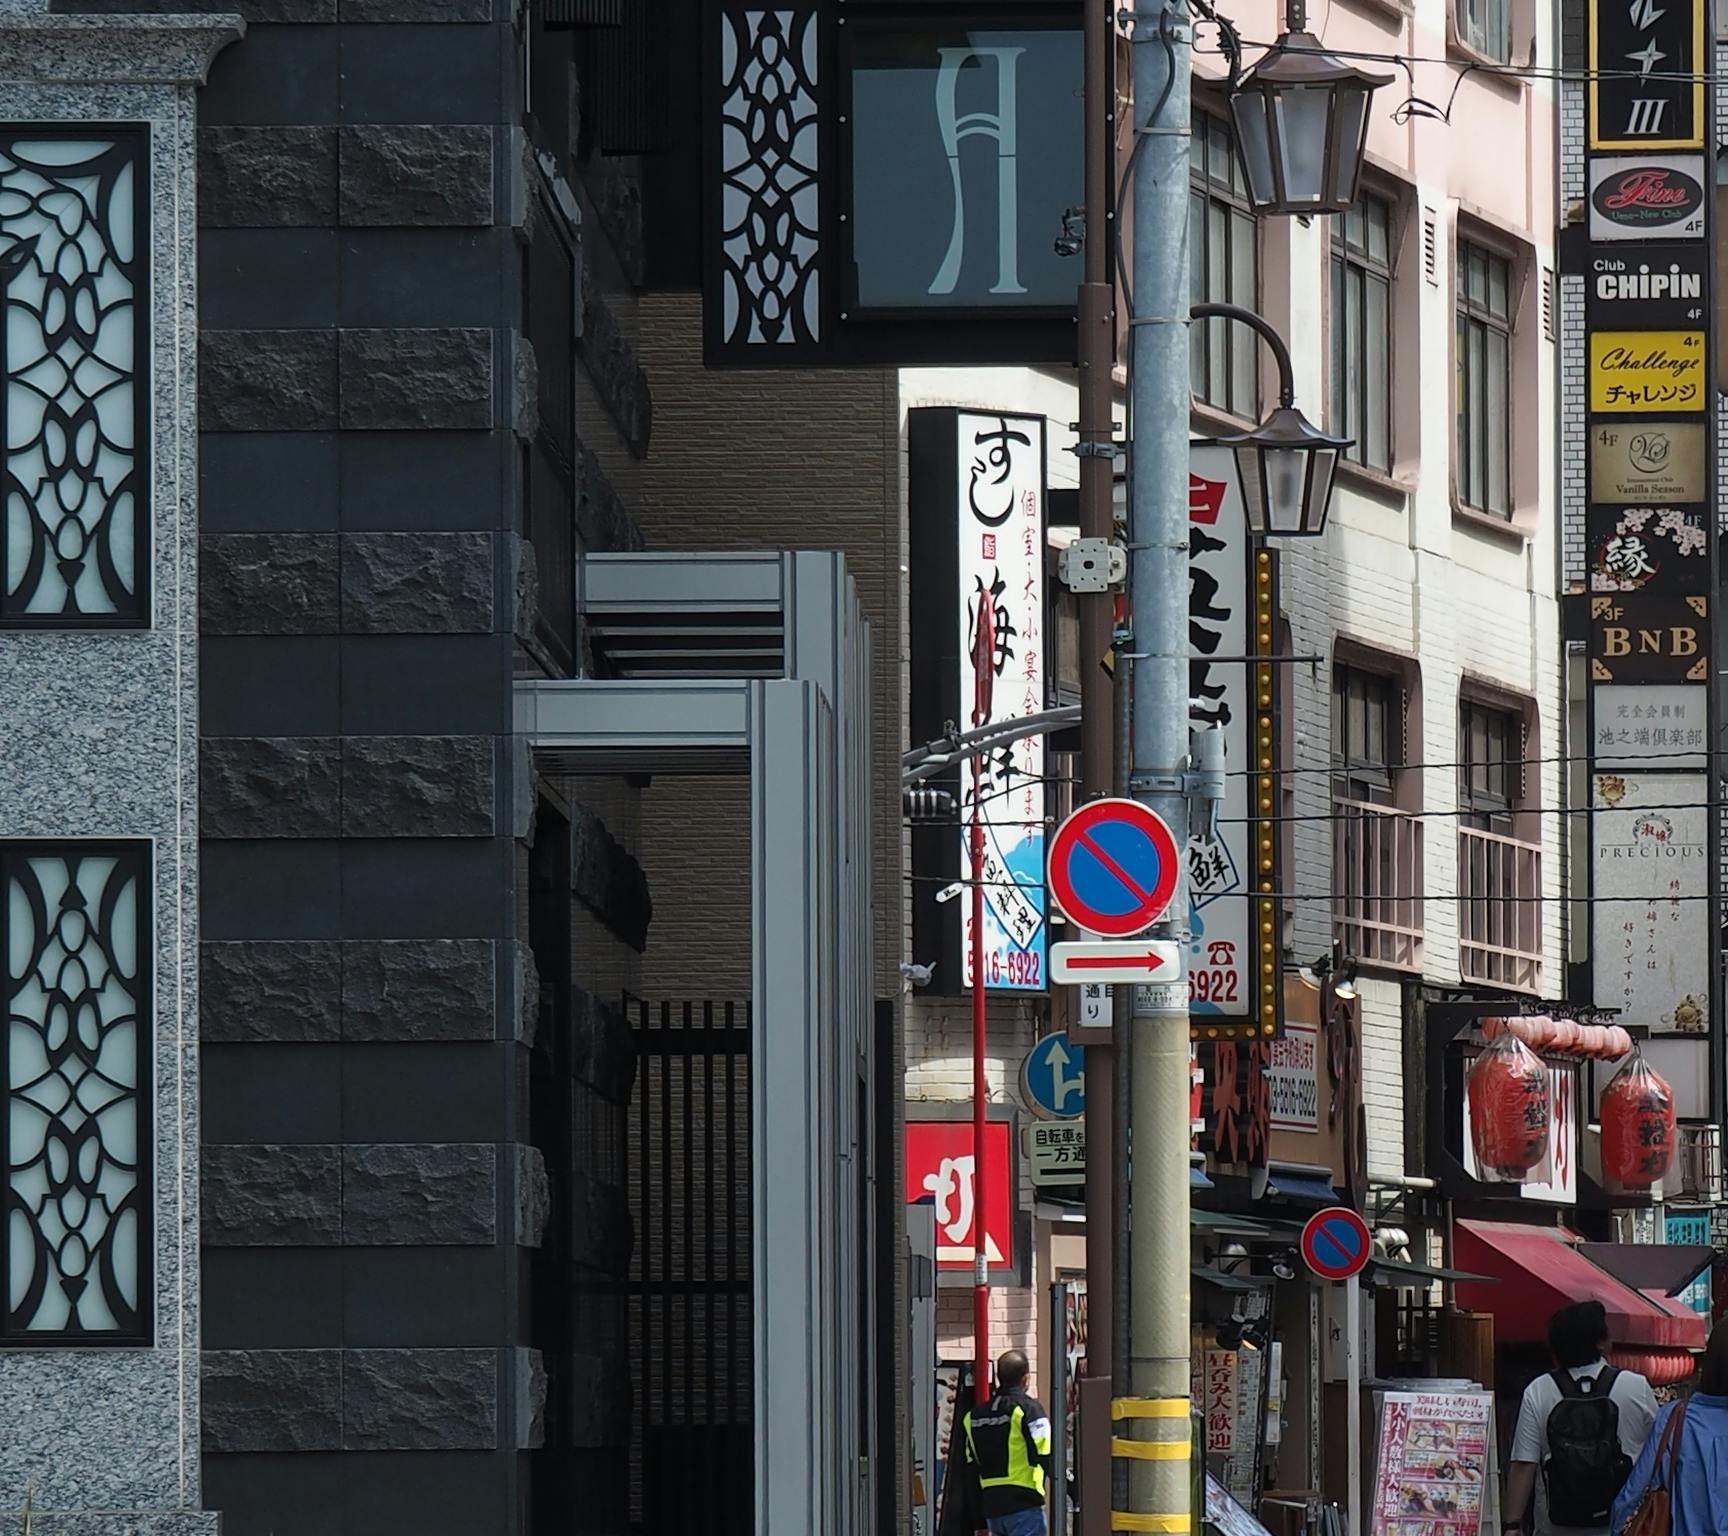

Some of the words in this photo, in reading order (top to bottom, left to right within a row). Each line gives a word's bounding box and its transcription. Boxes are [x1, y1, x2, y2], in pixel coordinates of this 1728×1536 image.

[1685, 221, 1703, 232] 4F
[1593, 259, 1626, 271] Club
[1687, 309, 1703, 320] 4F
[1683, 336, 1700, 348] 4F
[1600, 346, 1700, 378] Challenge
[1604, 382, 1698, 405] チャレンジ
[1598, 429, 1619, 447] 4F
[968, 417, 1032, 527] すし
[1616, 484, 1649, 494] Vanilla
[1651, 484, 1685, 494] Season
[1605, 538, 1651, 578] 縁
[1604, 607, 1624, 621] 3F
[1616, 704, 1686, 720] 完全会員制
[1599, 728, 1703, 747] 池之端倶楽部
[1599, 847, 1705, 859] PRECIOUS
[966, 951, 1040, 986] 516-6922
[1207, 1353, 1234, 1452] 昼呑み大歓迎
